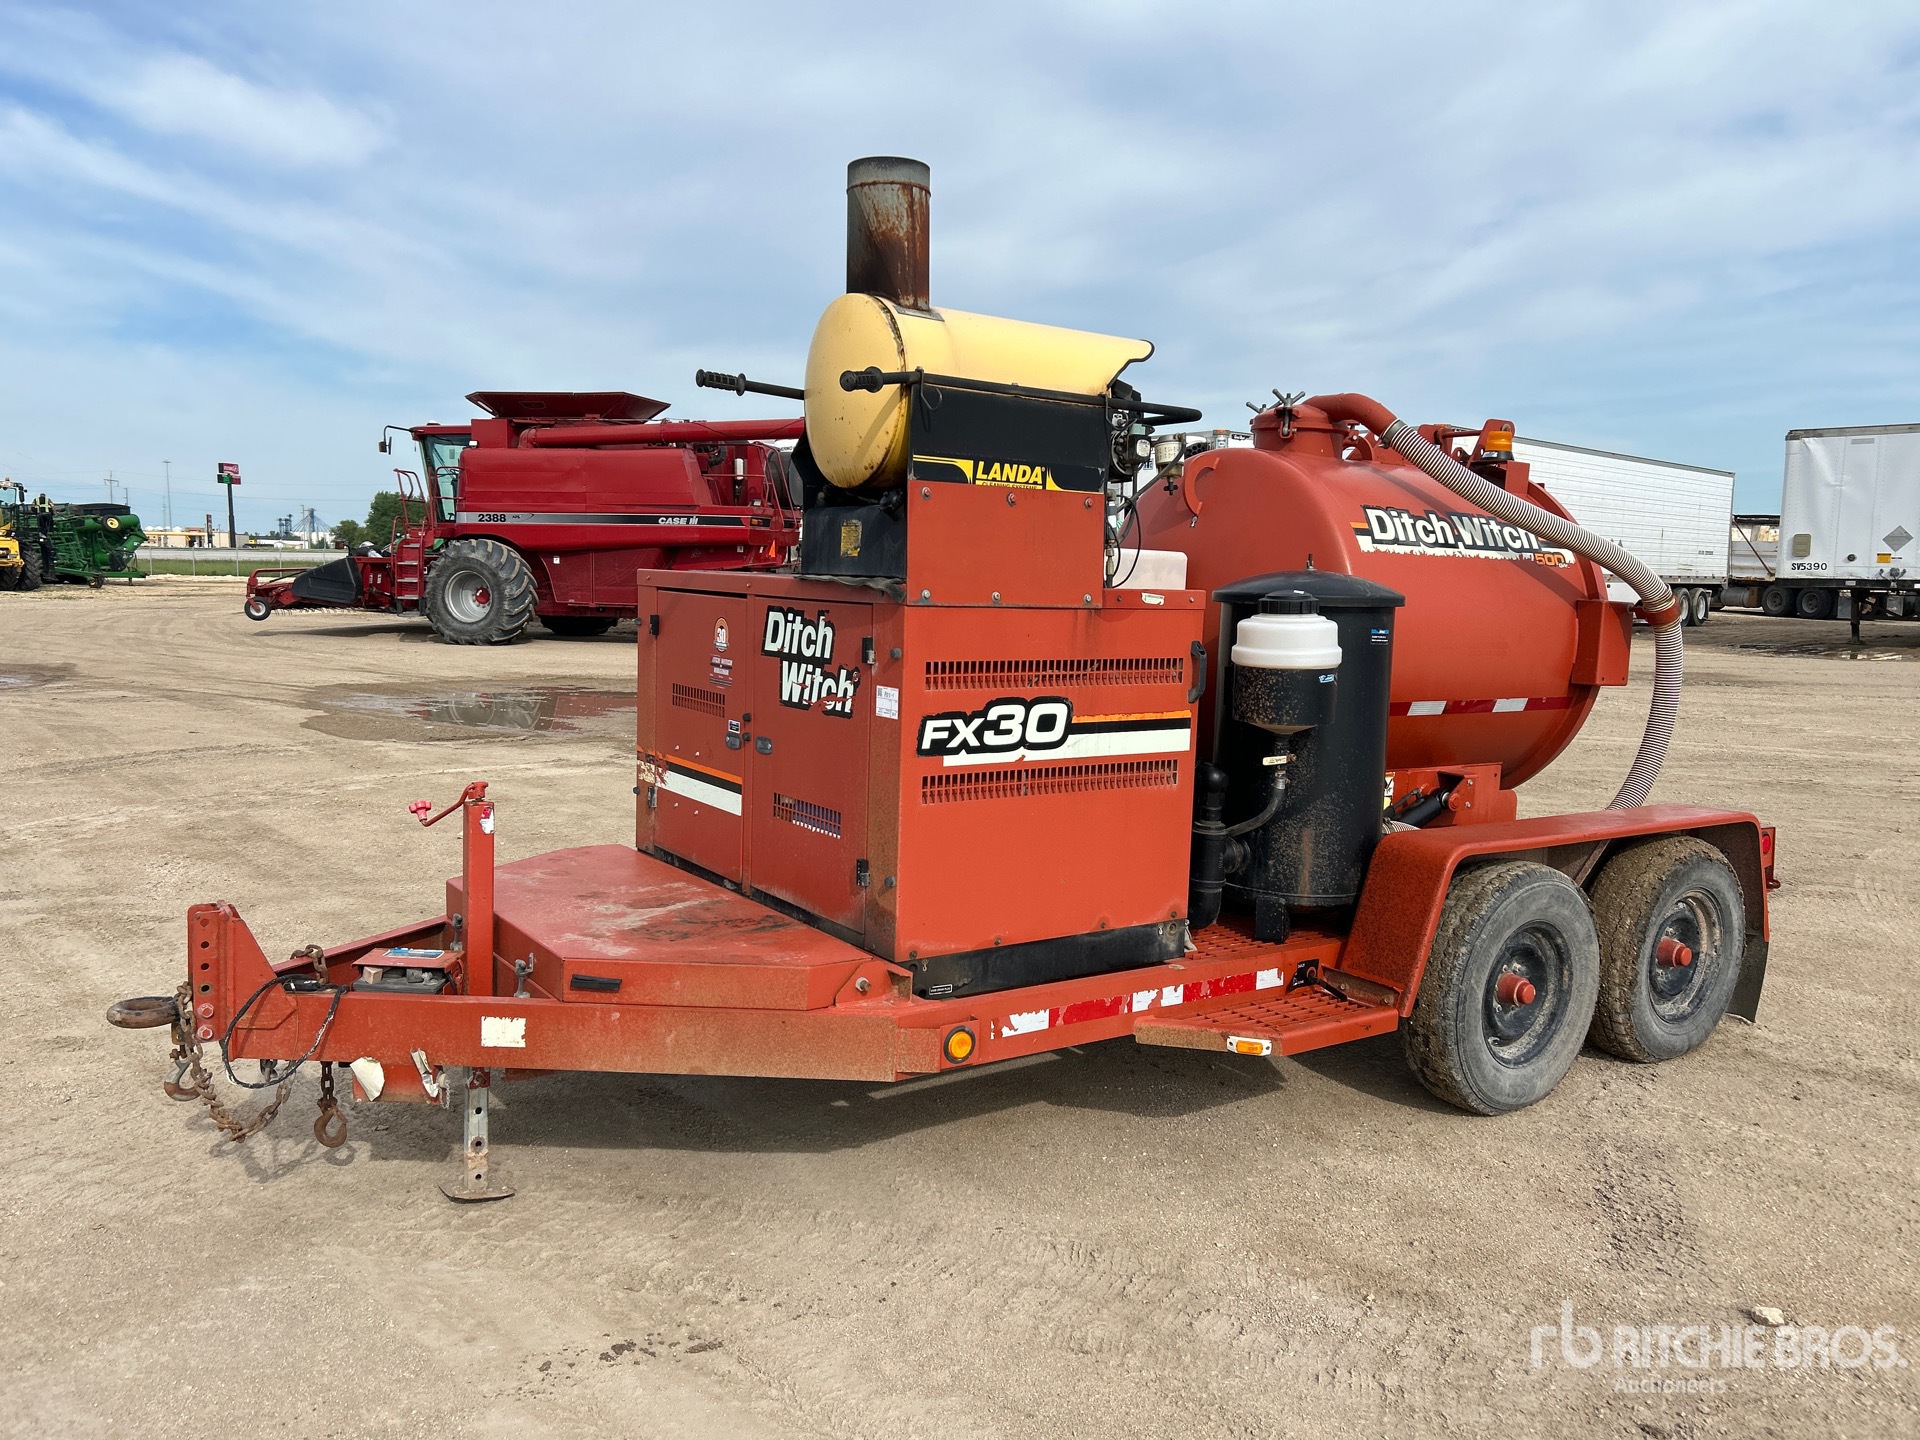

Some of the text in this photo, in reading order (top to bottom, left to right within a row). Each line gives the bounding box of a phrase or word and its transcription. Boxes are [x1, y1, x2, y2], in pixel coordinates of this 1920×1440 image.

[976, 461, 1043, 484] LANDA
[478, 513, 506, 522] 2388
[658, 517, 687, 525] CASE
[1366, 508, 1539, 550] Ditch Witch
[1534, 553, 1565, 566] 500
[1791, 562, 1828, 571] SV5390
[764, 611, 833, 659] Ditch
[782, 660, 854, 713] Witch
[921, 703, 1069, 750] FX30
